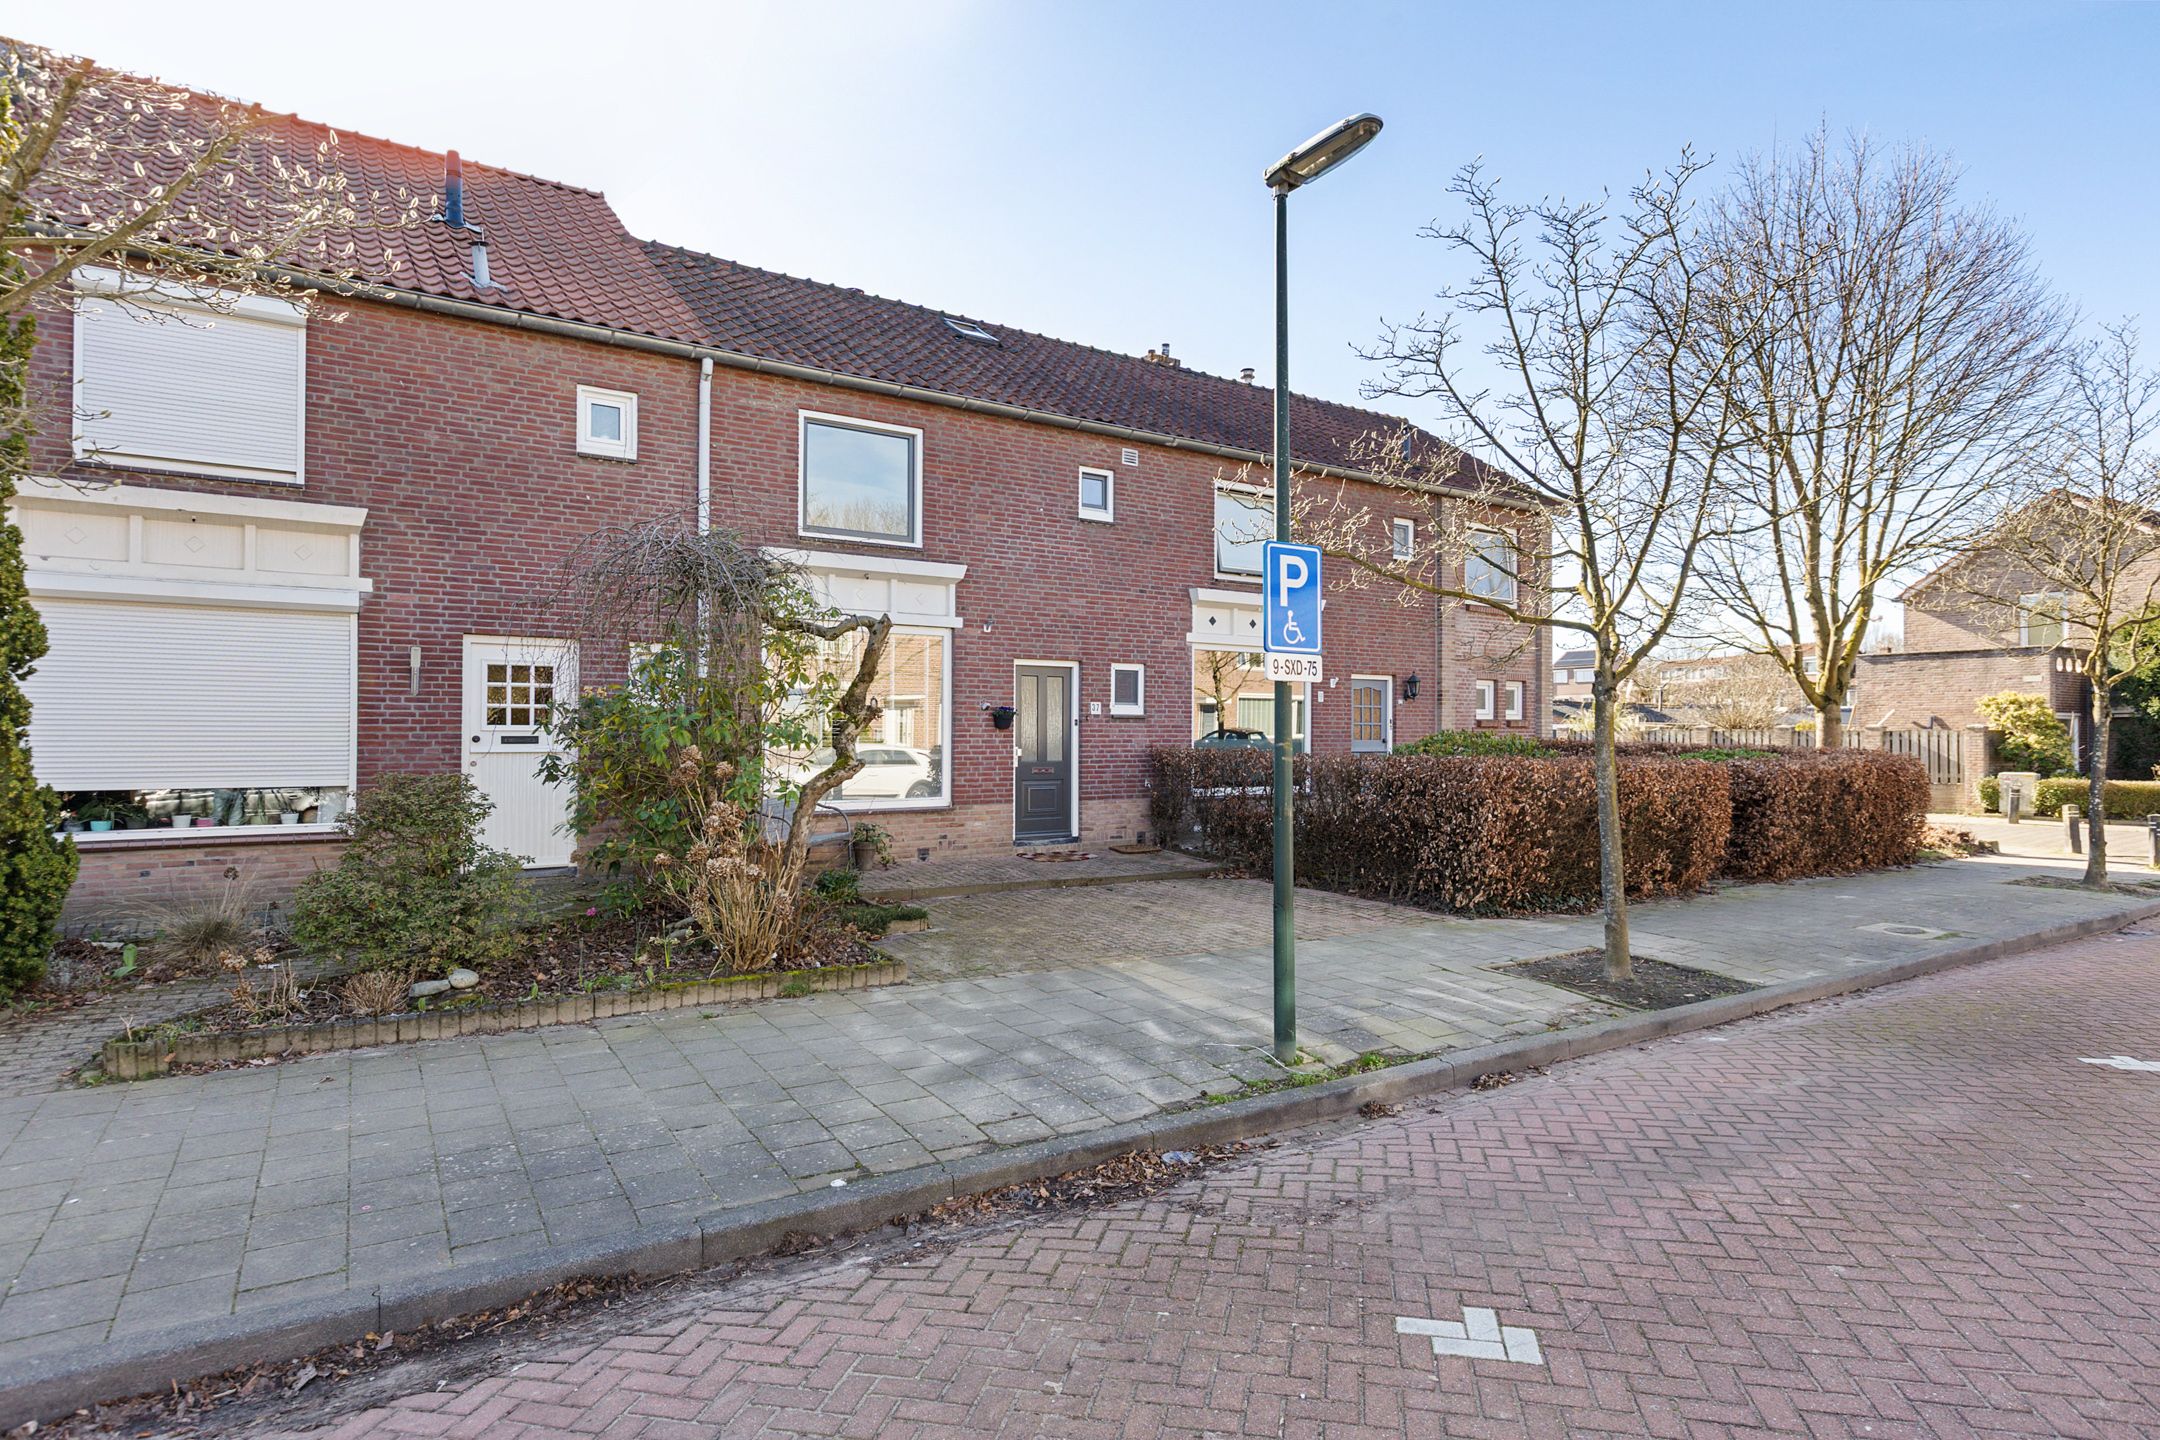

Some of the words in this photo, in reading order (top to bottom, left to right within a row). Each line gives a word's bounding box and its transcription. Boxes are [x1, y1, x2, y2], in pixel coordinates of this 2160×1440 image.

[1279, 554, 1309, 607] P
[1272, 658, 1318, 677] 9-SXD-75
[1091, 703, 1100, 712] 37
